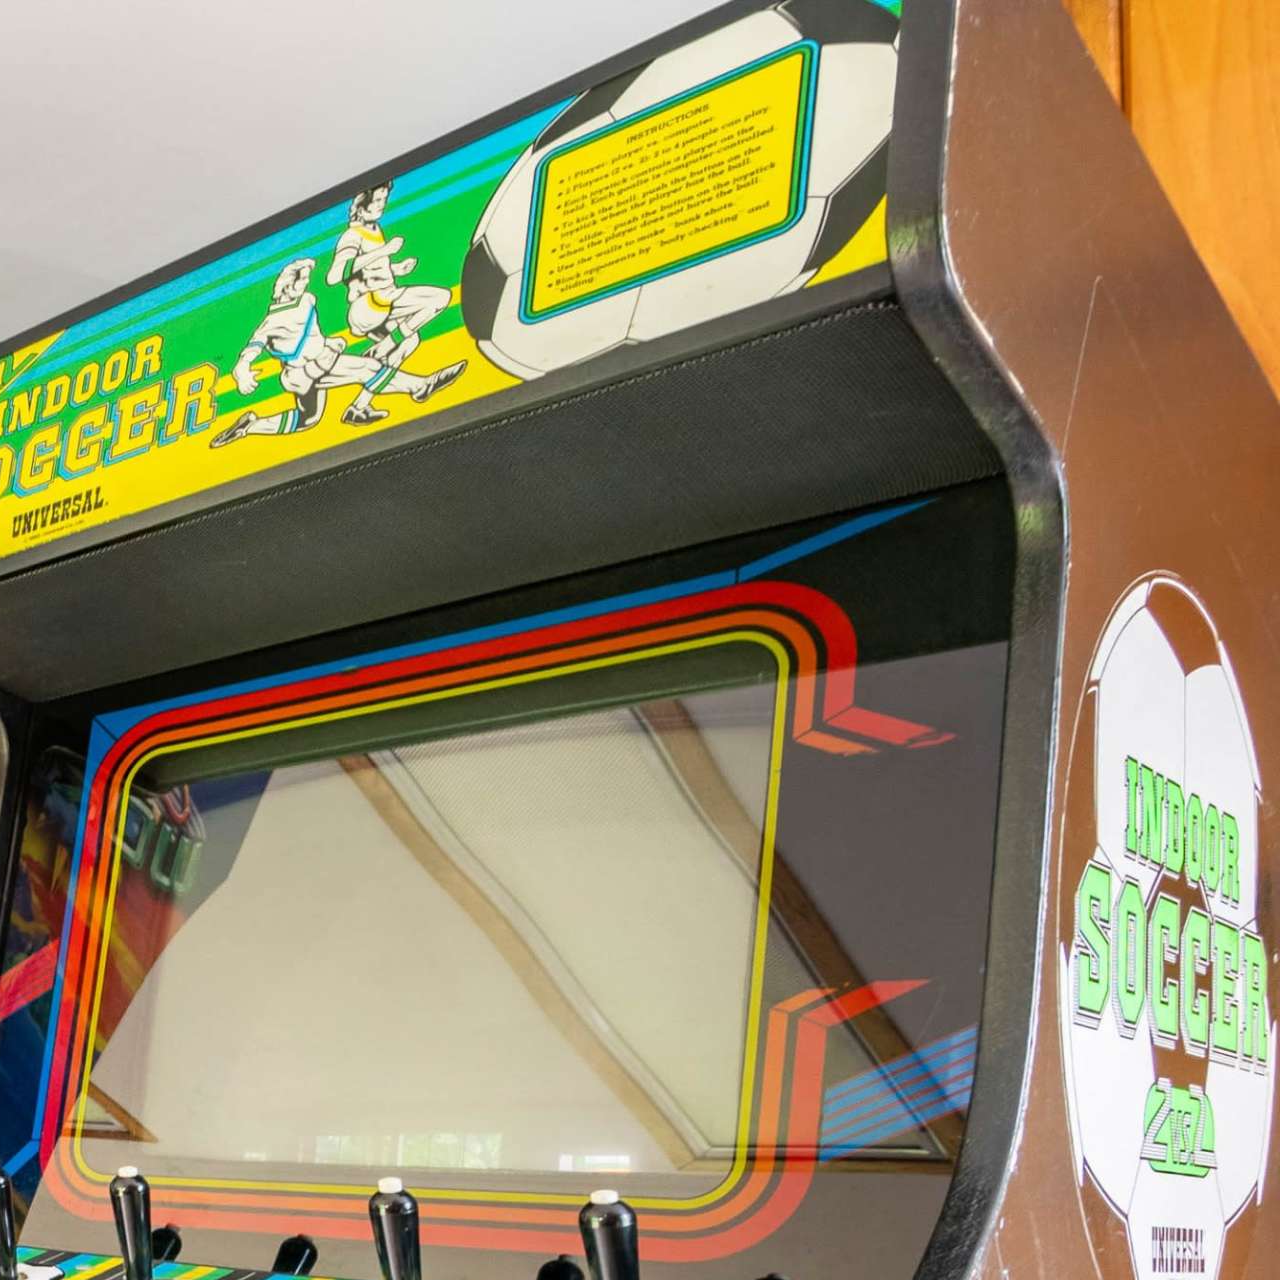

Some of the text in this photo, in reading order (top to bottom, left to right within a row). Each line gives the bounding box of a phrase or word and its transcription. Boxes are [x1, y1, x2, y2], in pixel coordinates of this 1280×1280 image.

[626, 103, 709, 143] INSTRUCTIONS
[682, 125, 717, 147] people
[683, 139, 717, 160] player
[576, 210, 595, 222] kick
[642, 180, 668, 197] push
[689, 158, 724, 177] button
[591, 190, 615, 205] Each
[599, 206, 627, 223] when
[648, 184, 682, 204] player
[613, 214, 638, 230] push
[660, 192, 694, 211] button
[732, 159, 775, 184] joystick
[559, 244, 584, 259] when
[605, 223, 636, 242] player
[639, 212, 664, 228] does
[686, 193, 713, 210] have
[594, 241, 622, 258] walls
[636, 225, 665, 242] make
[12, 487, 104, 538] UNIVERSAL
[1125, 755, 1239, 909] INDOOR
[1073, 859, 1268, 1075] SOCCER
